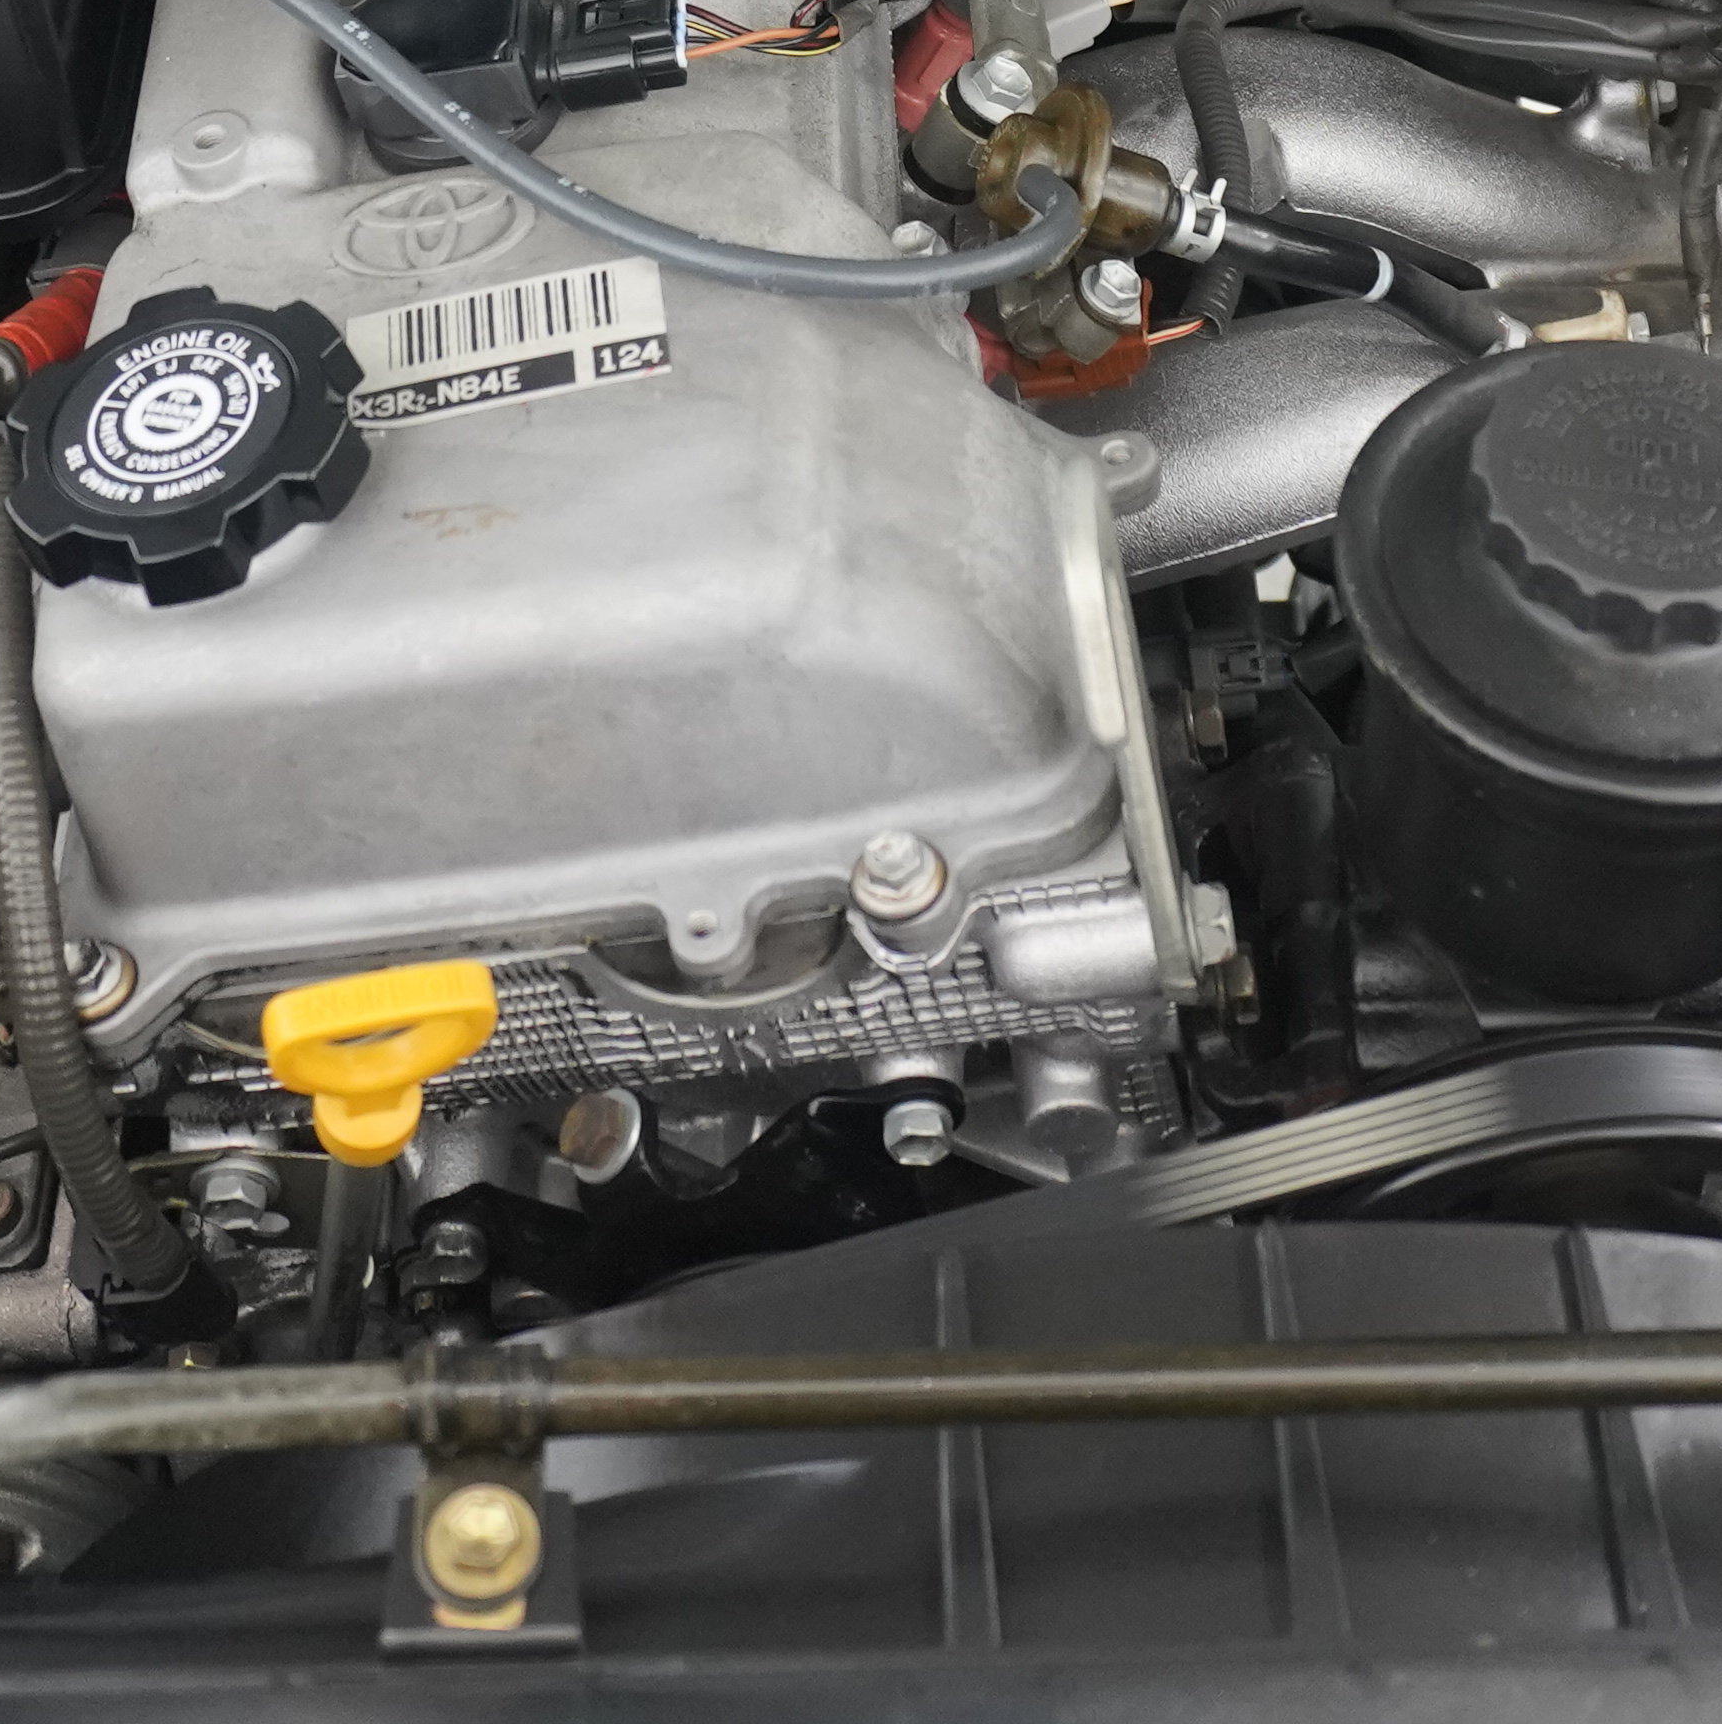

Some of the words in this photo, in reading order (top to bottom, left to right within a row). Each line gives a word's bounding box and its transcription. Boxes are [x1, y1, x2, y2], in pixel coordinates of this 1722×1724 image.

[115, 329, 215, 373] ENGINE
[215, 332, 253, 360] OIL
[599, 339, 664, 374] 124
[119, 372, 149, 399] API
[154, 357, 179, 376] SJ
[189, 355, 225, 376] SAE
[125, 427, 230, 473] CONSERVING
[64, 443, 88, 472] SEE
[153, 464, 227, 502] MANUAL
